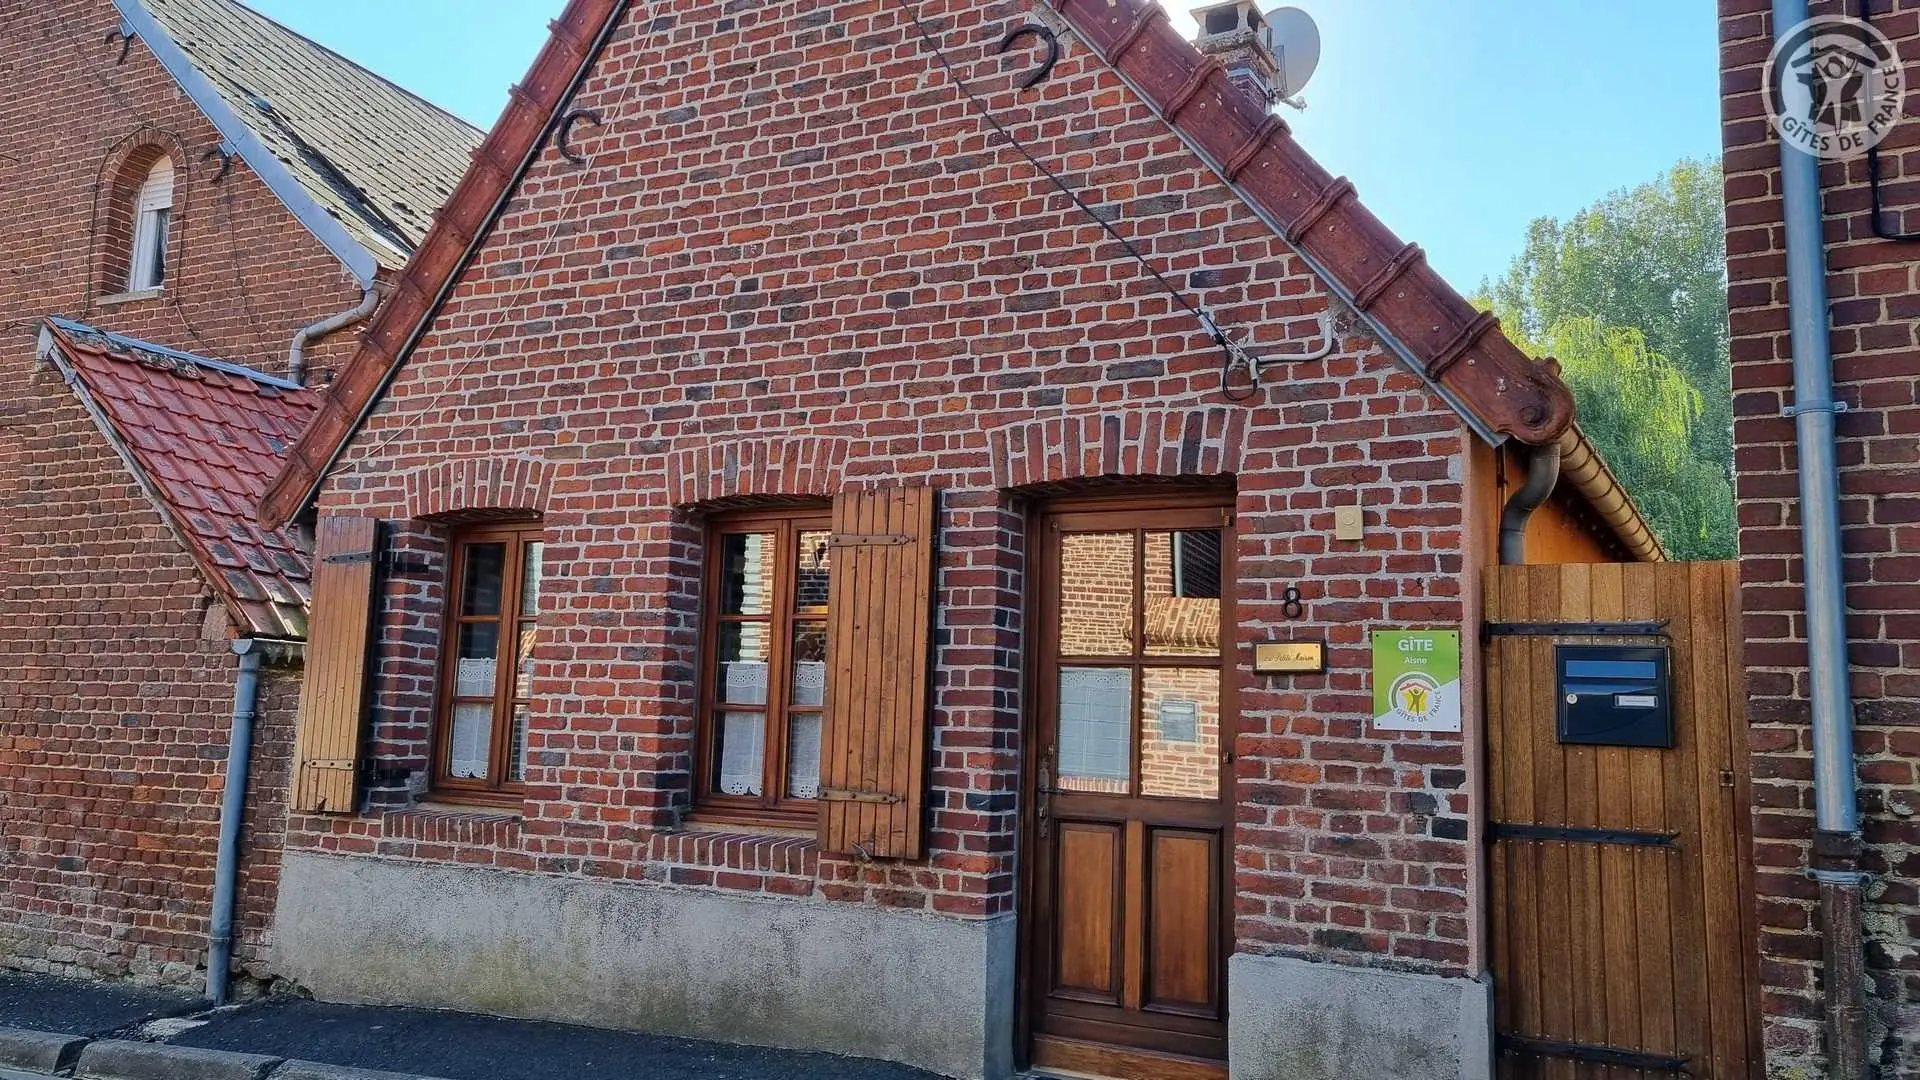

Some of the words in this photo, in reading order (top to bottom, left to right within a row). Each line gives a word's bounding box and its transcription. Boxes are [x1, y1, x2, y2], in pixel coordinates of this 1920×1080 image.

[1283, 587, 1302, 618] 8
[1398, 636, 1433, 652] GÎTE
[1418, 715, 1429, 723] DE
